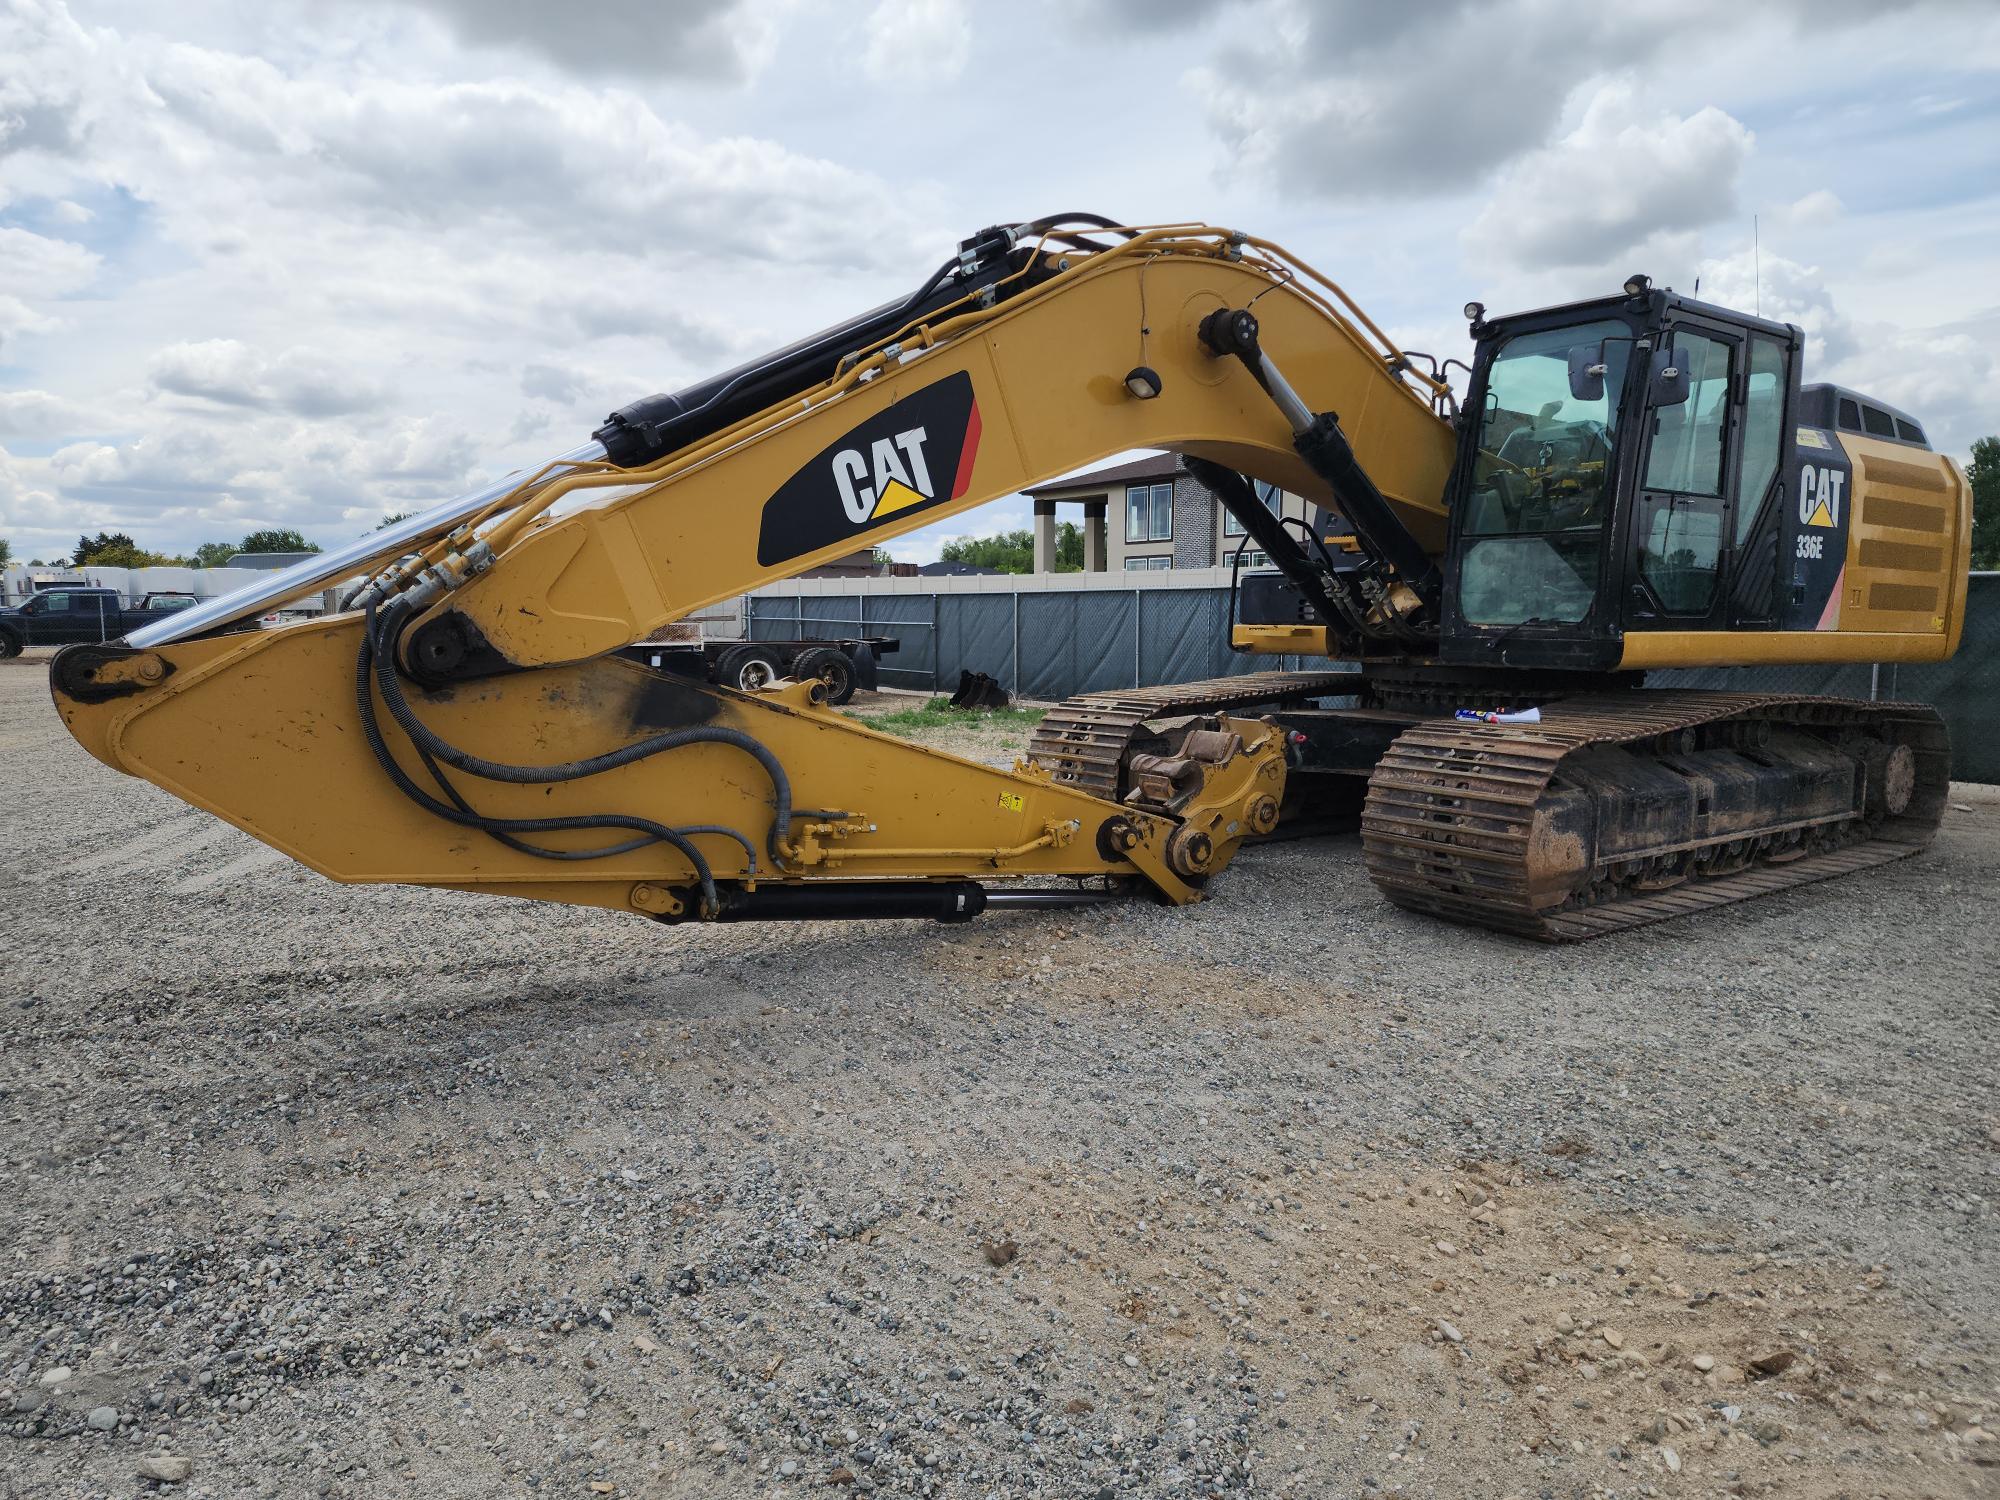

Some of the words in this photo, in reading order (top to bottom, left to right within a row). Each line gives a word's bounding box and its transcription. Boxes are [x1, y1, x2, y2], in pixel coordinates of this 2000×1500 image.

[832, 426, 934, 524] CAT
[1799, 464, 1845, 528] CAT
[1796, 534, 1824, 559] 336E
